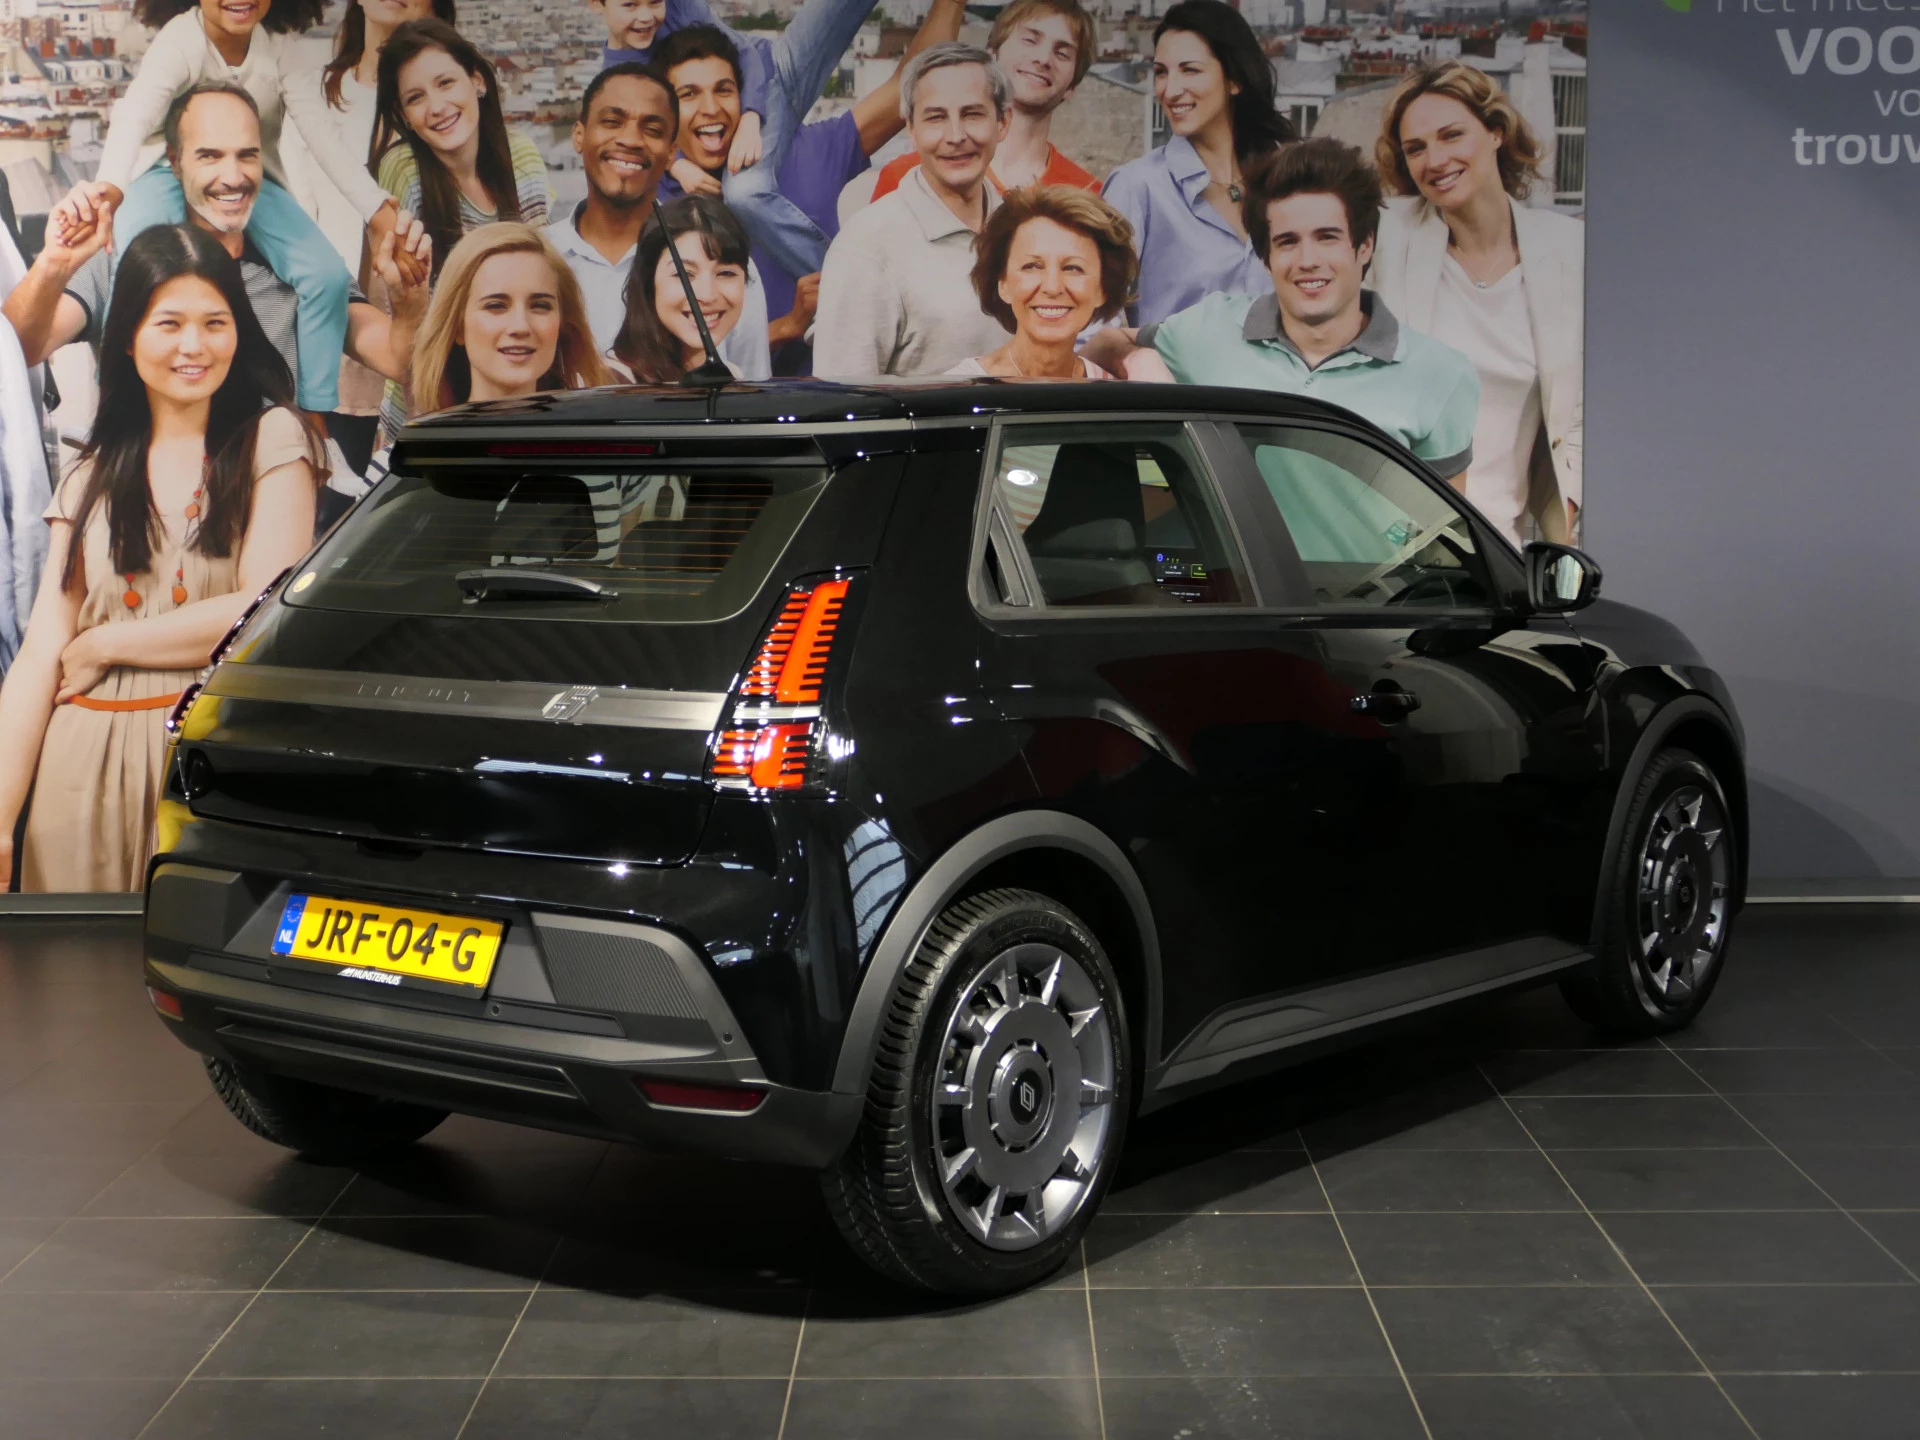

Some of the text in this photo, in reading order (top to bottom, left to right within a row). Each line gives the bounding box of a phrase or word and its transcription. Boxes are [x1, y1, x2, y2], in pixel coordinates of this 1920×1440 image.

[1775, 26, 1920, 75] voo
[278, 929, 293, 944] NL
[306, 907, 481, 972] JRF-04-G
